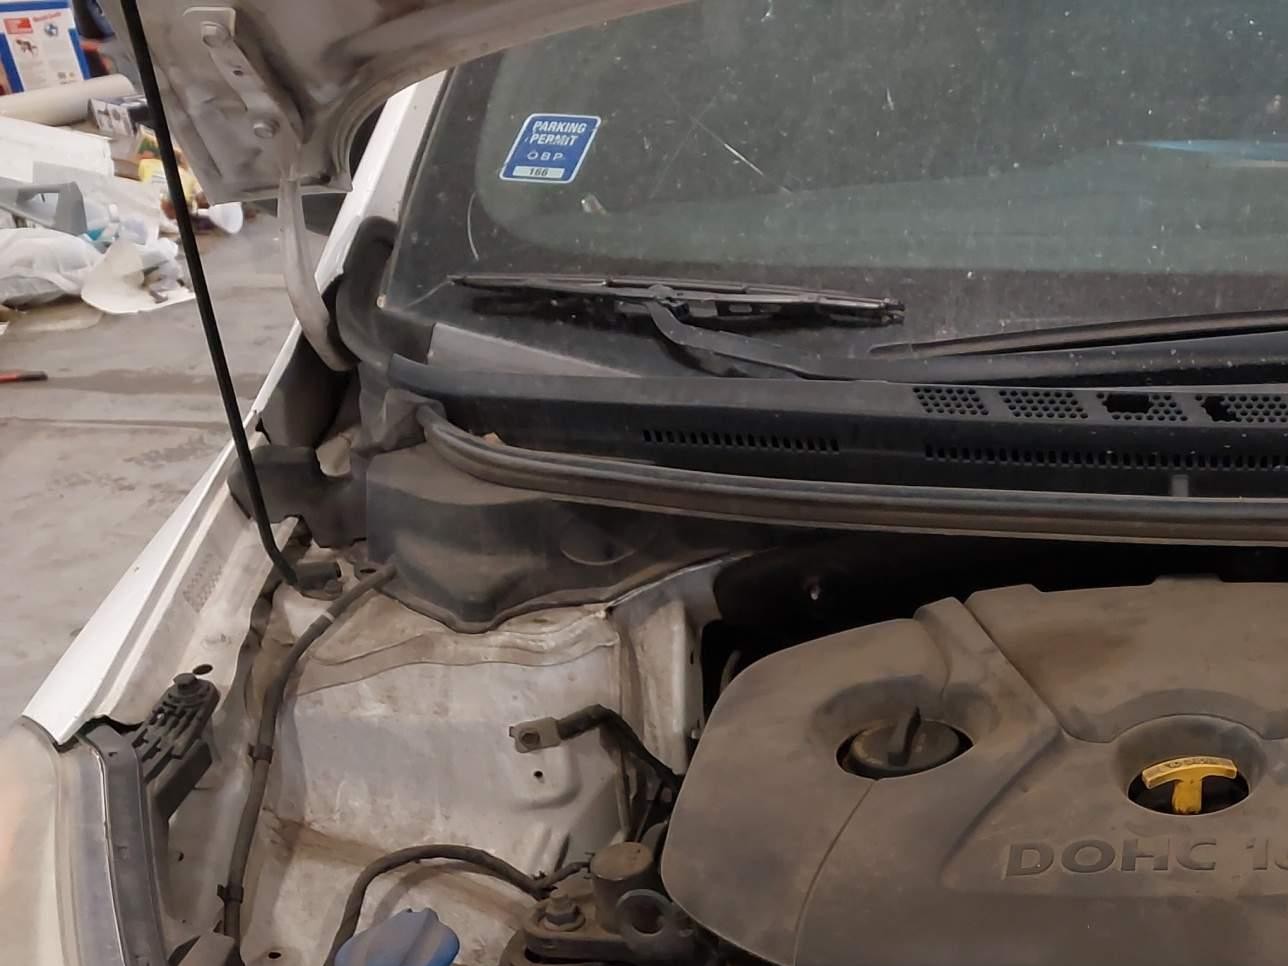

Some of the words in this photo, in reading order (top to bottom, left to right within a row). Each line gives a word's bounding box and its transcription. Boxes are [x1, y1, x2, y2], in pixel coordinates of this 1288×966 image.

[531, 120, 587, 134] PARKING
[528, 133, 578, 146] PERMIT
[1003, 838, 1217, 879] DOHC
